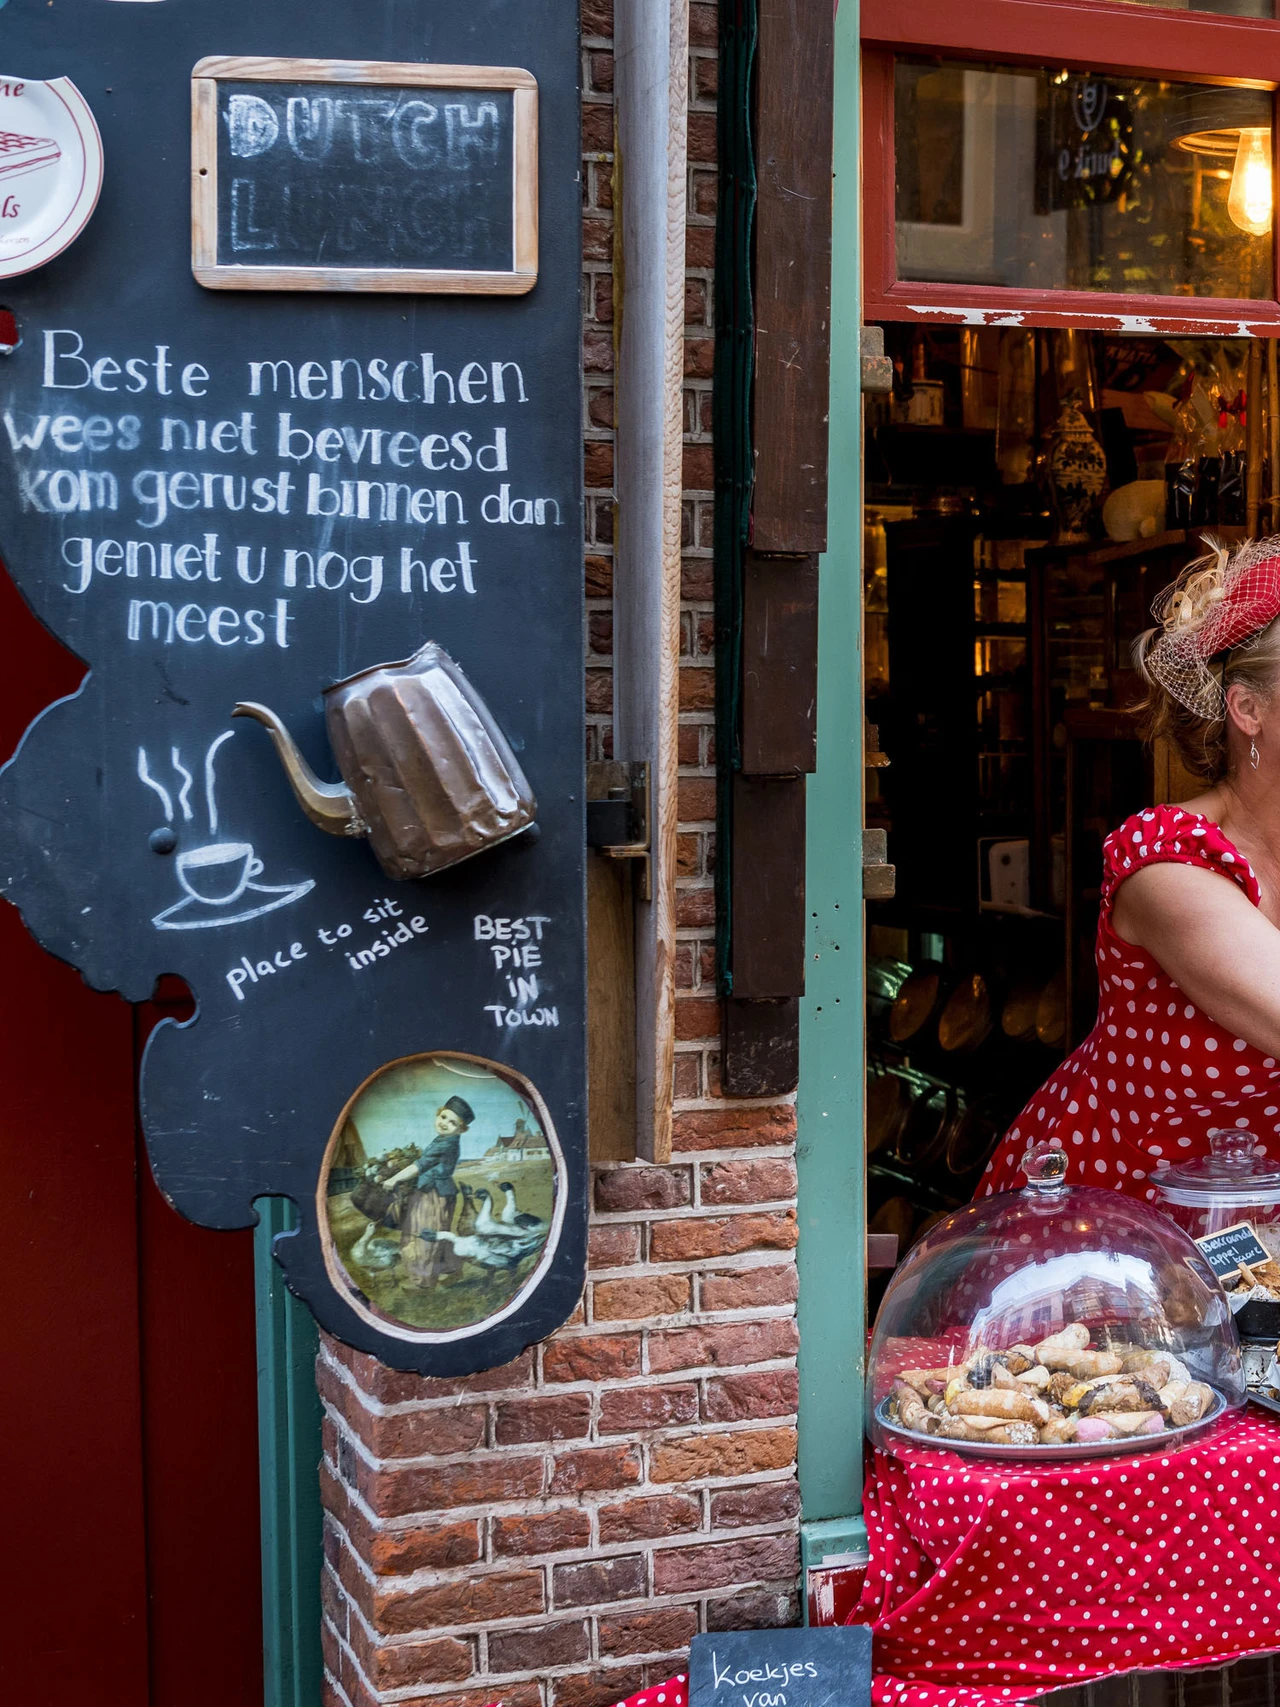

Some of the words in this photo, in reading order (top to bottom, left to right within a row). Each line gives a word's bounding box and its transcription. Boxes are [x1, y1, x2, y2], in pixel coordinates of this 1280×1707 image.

[223, 94, 499, 171] DUTCH
[41, 329, 209, 397] Beste
[249, 352, 530, 404] menschen
[2, 410, 141, 454] wees
[160, 413, 257, 454] niet
[278, 412, 509, 472] bevreesd
[18, 467, 118, 513] kom
[132, 470, 297, 528] gerust
[307, 471, 468, 524] binnen
[480, 484, 564, 526] dan
[61, 533, 222, 594] geniet
[236, 546, 266, 584] u
[284, 549, 384, 604] nog
[400, 541, 479, 595] het
[127, 599, 295, 648] meest
[225, 942, 308, 1000] place
[317, 919, 353, 946] to
[362, 897, 404, 924] sit
[346, 913, 429, 971] inside
[474, 915, 551, 942] BEST
[1209, 1247, 1240, 1266] appel
[743, 1690, 787, 1707] van
